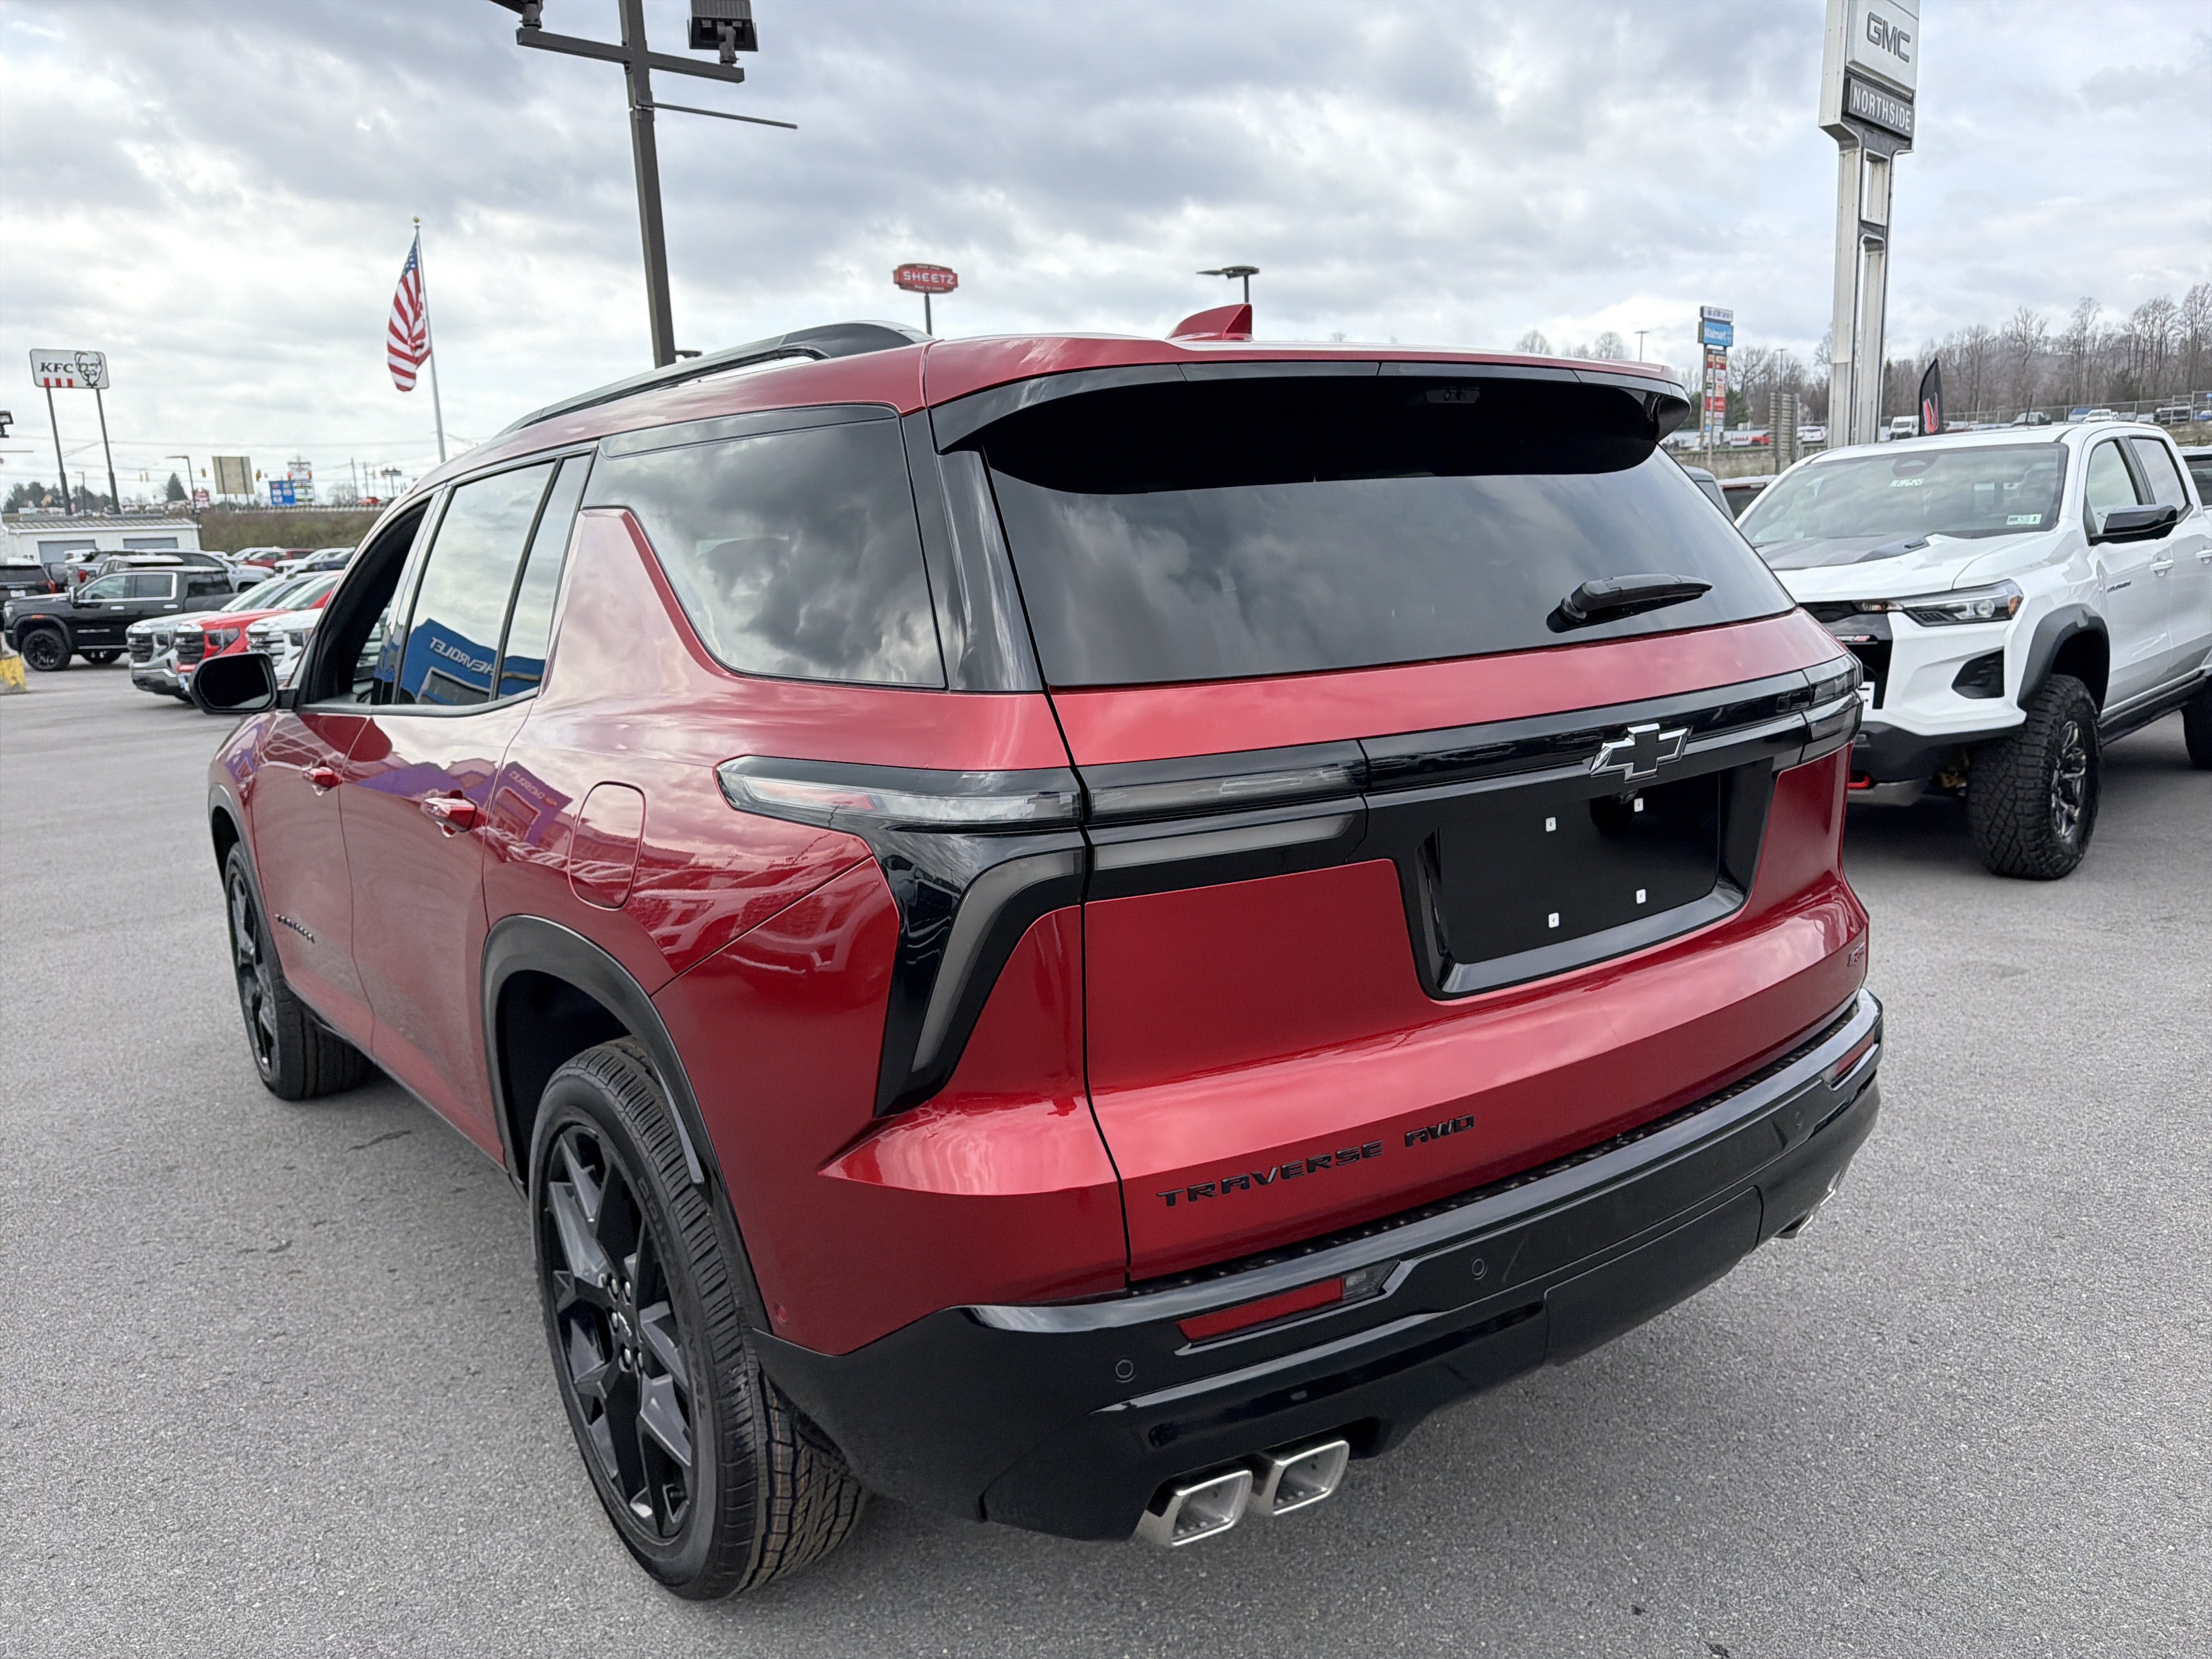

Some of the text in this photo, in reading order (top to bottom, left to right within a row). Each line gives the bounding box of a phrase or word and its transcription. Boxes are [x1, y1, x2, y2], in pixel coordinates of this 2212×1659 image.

[1867, 12, 1911, 63] GMC
[1853, 86, 1911, 131] NORTHSIDE
[903, 270, 954, 284] SHEETZ
[40, 362, 74, 374] KFC
[1156, 1114, 1475, 1206] TRAVERSE AWD
